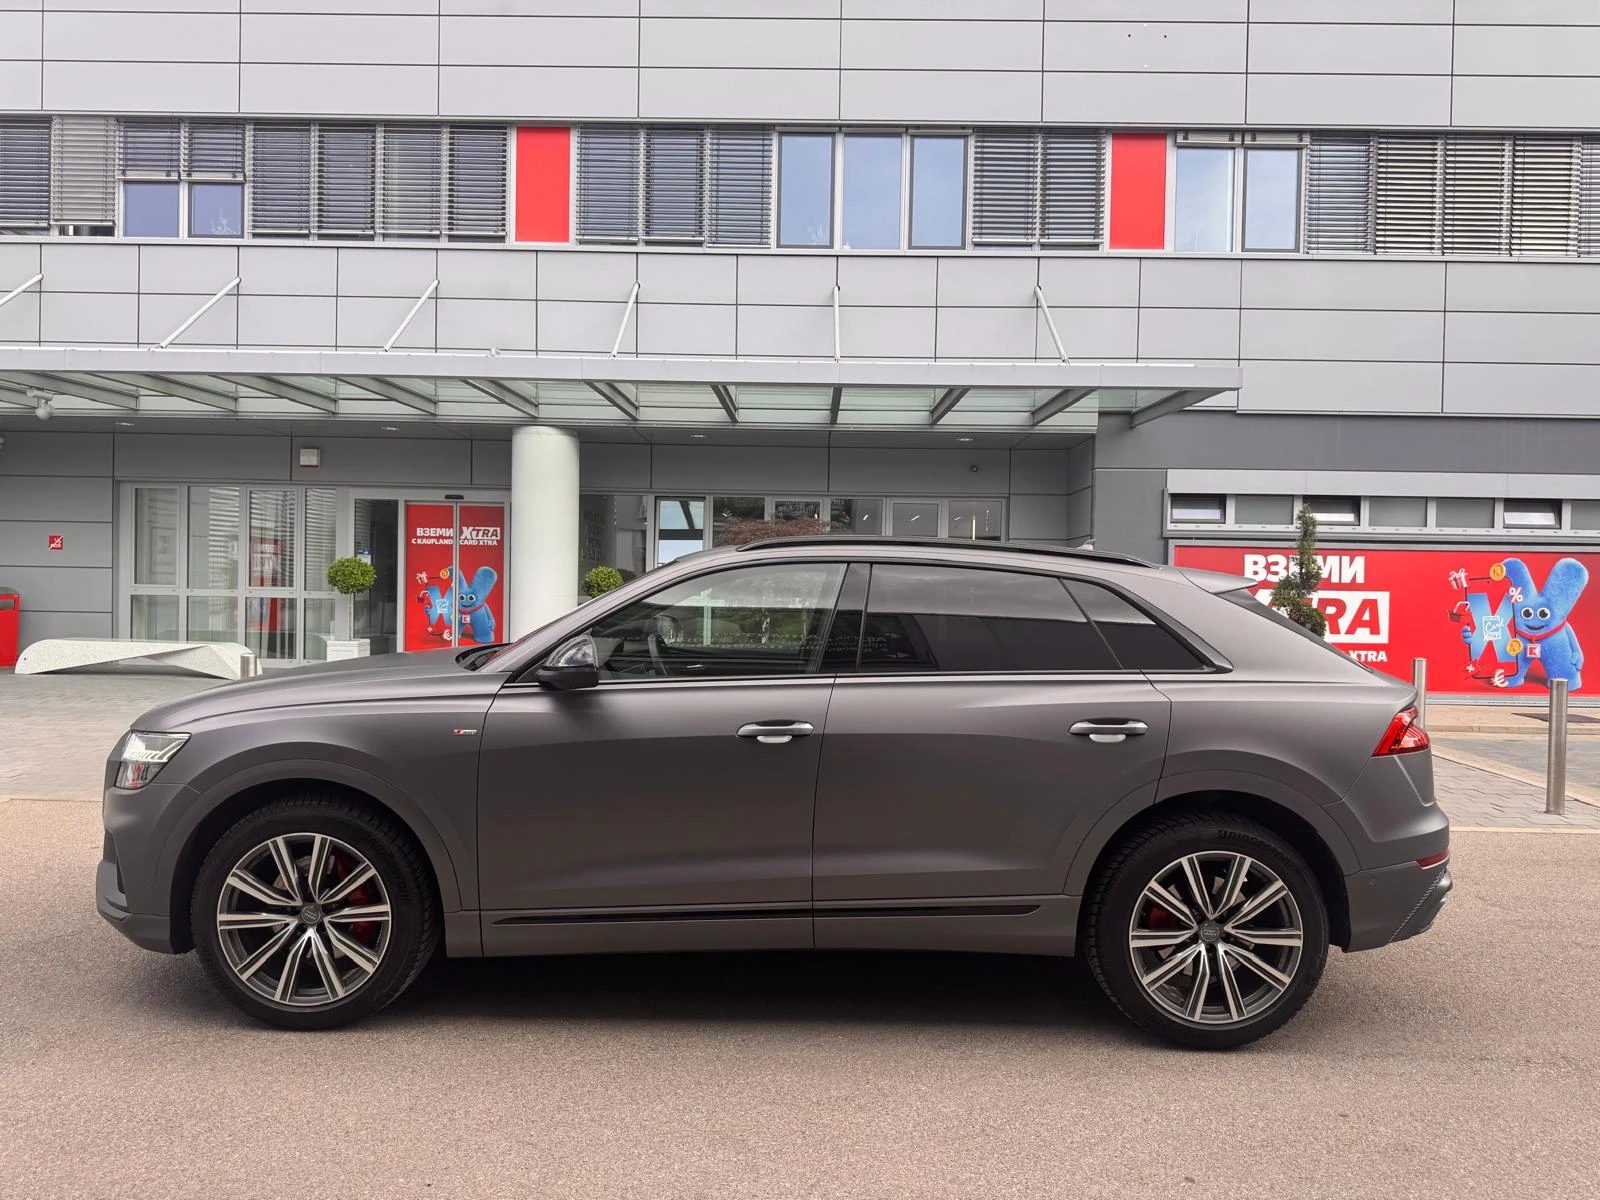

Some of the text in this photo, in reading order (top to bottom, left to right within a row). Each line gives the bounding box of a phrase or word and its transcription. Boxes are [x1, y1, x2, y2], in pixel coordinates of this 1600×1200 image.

[416, 526, 501, 540] ВЗЕМИ XTRA
[1244, 554, 1365, 583] ВЗМИ
